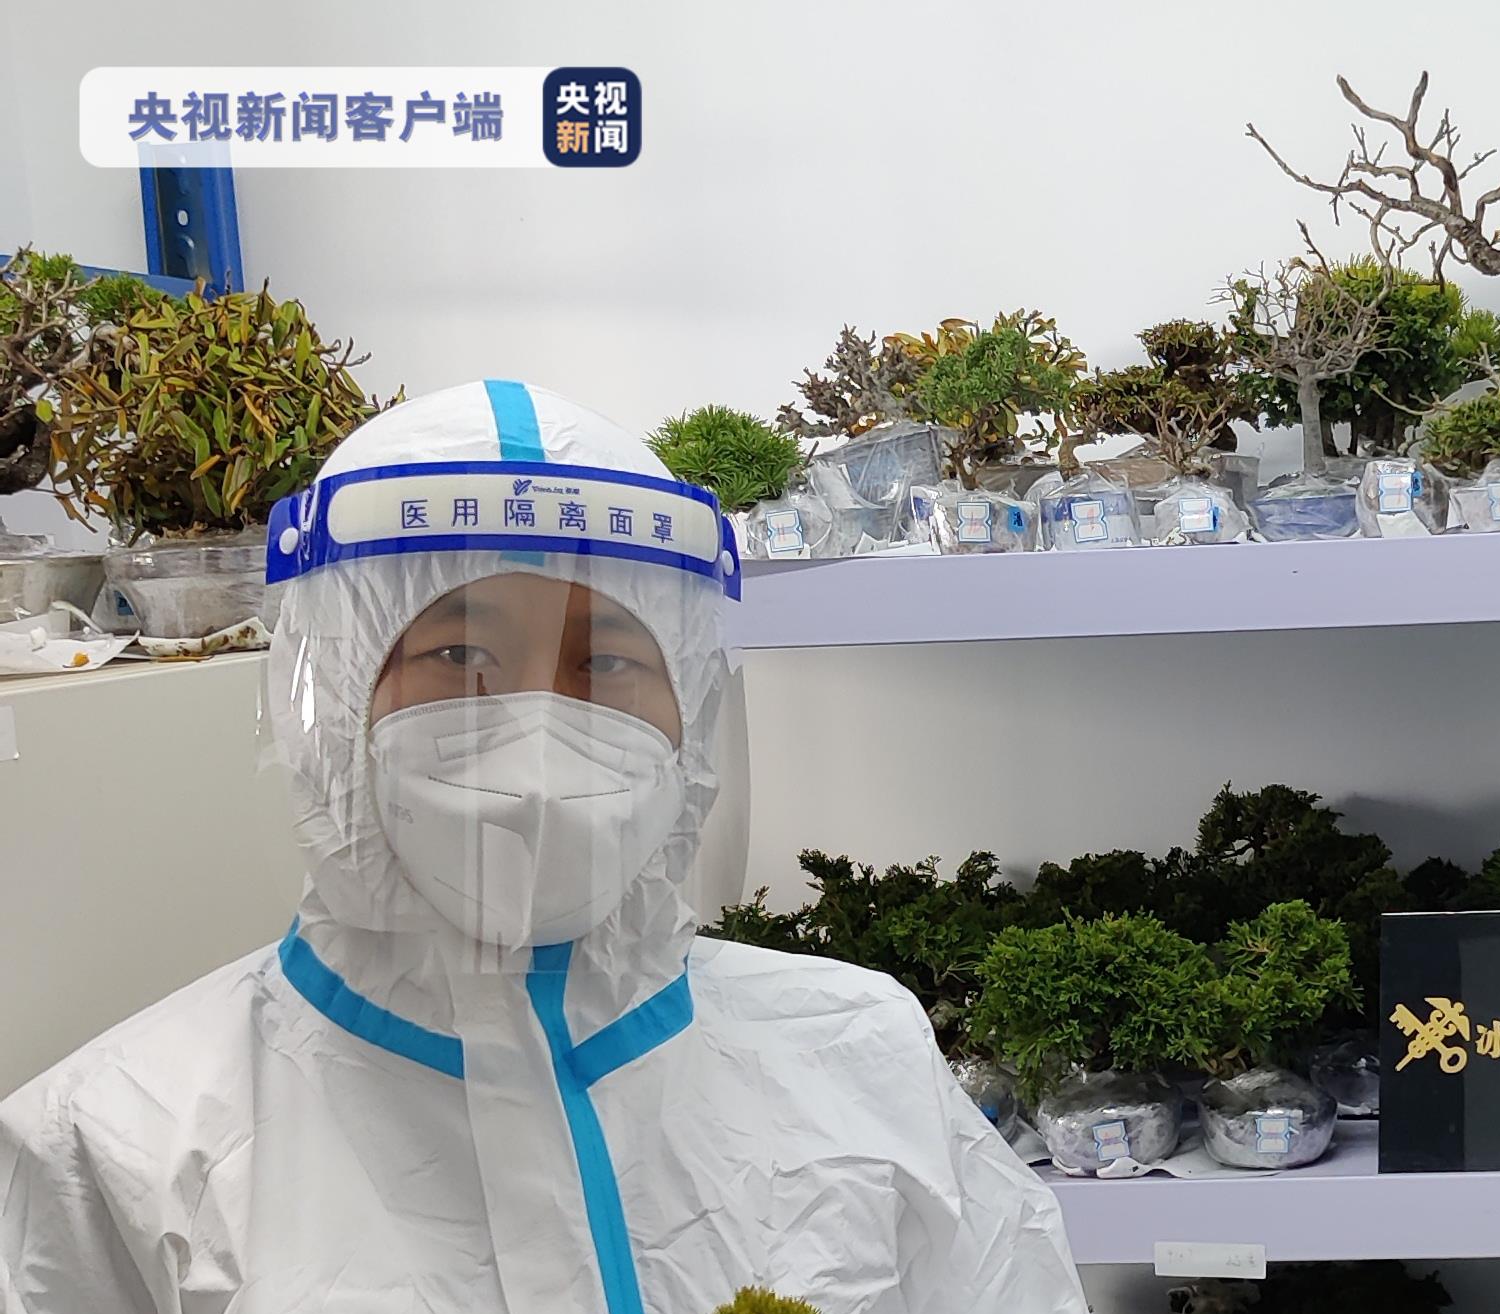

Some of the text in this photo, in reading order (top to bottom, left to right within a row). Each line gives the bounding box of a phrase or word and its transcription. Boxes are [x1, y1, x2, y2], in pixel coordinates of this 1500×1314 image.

[401, 498, 674, 543] 医用隔离面罩
